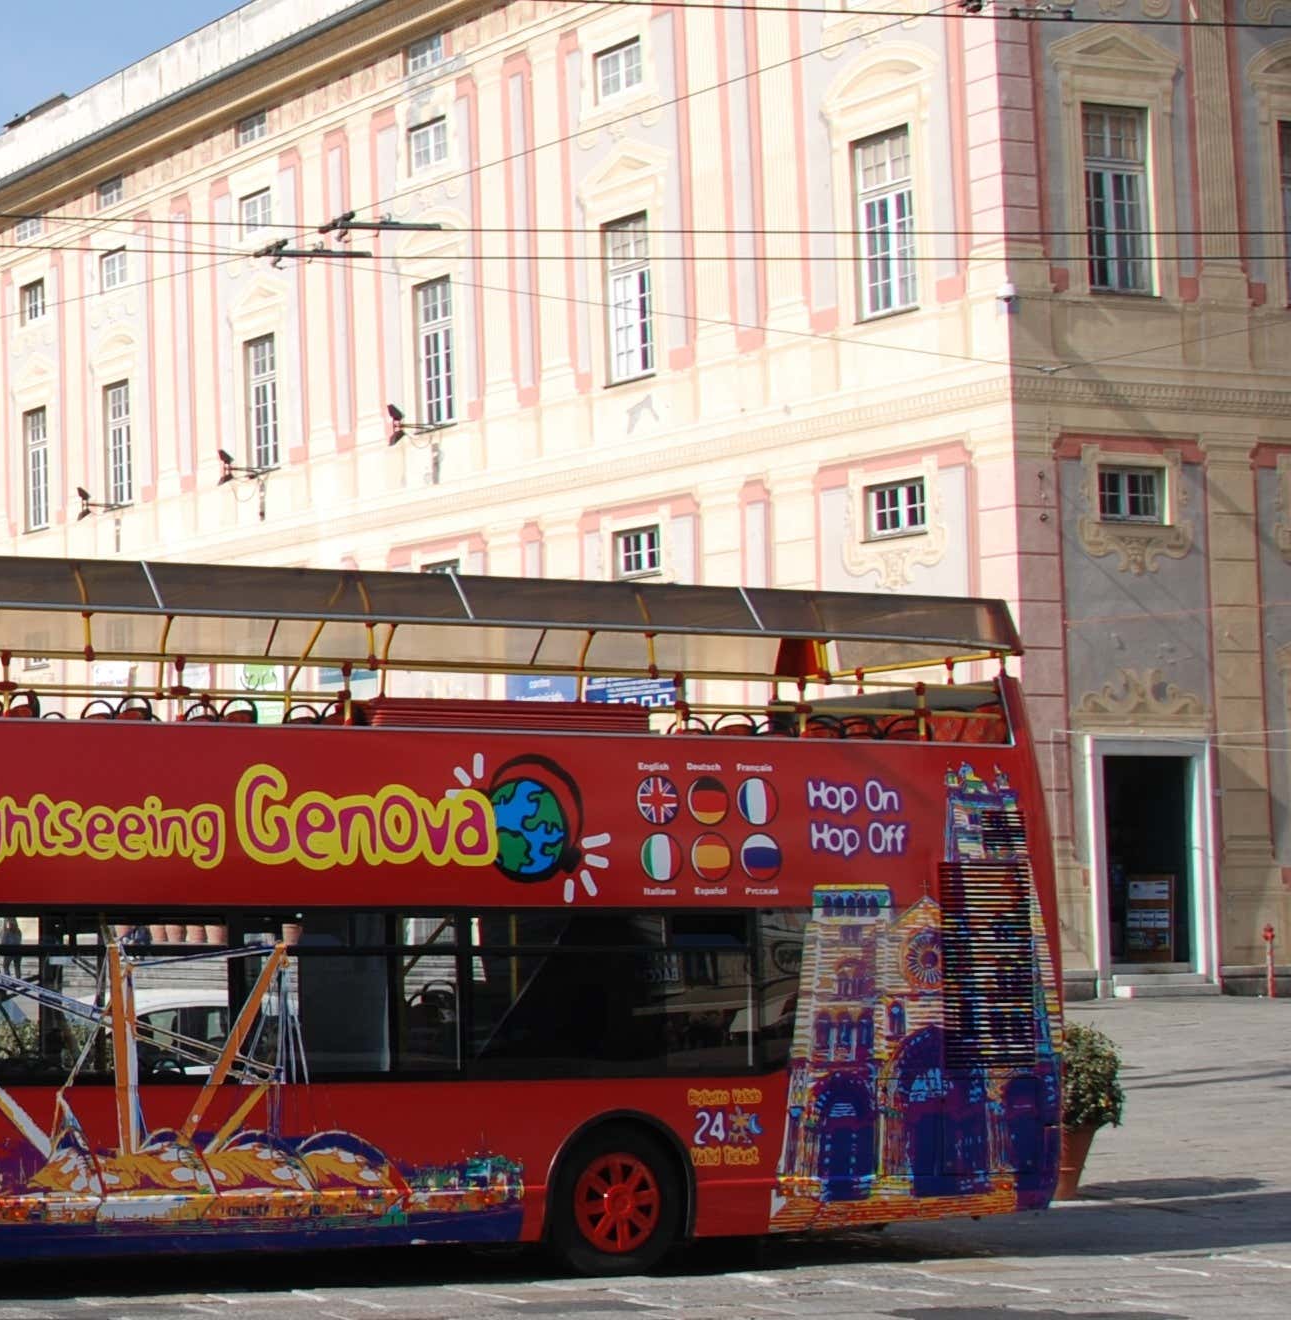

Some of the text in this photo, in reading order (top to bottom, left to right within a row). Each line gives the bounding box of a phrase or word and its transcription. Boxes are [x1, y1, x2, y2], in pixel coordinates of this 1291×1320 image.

[637, 762, 670, 772] English
[686, 762, 722, 772] Deutsch
[807, 780, 899, 815] Hop On
[236, 764, 498, 870] Genova
[810, 822, 907, 857] Hop Off
[643, 886, 677, 896] Italiano
[694, 885, 728, 896] Español
[694, 1111, 725, 1145] 24
